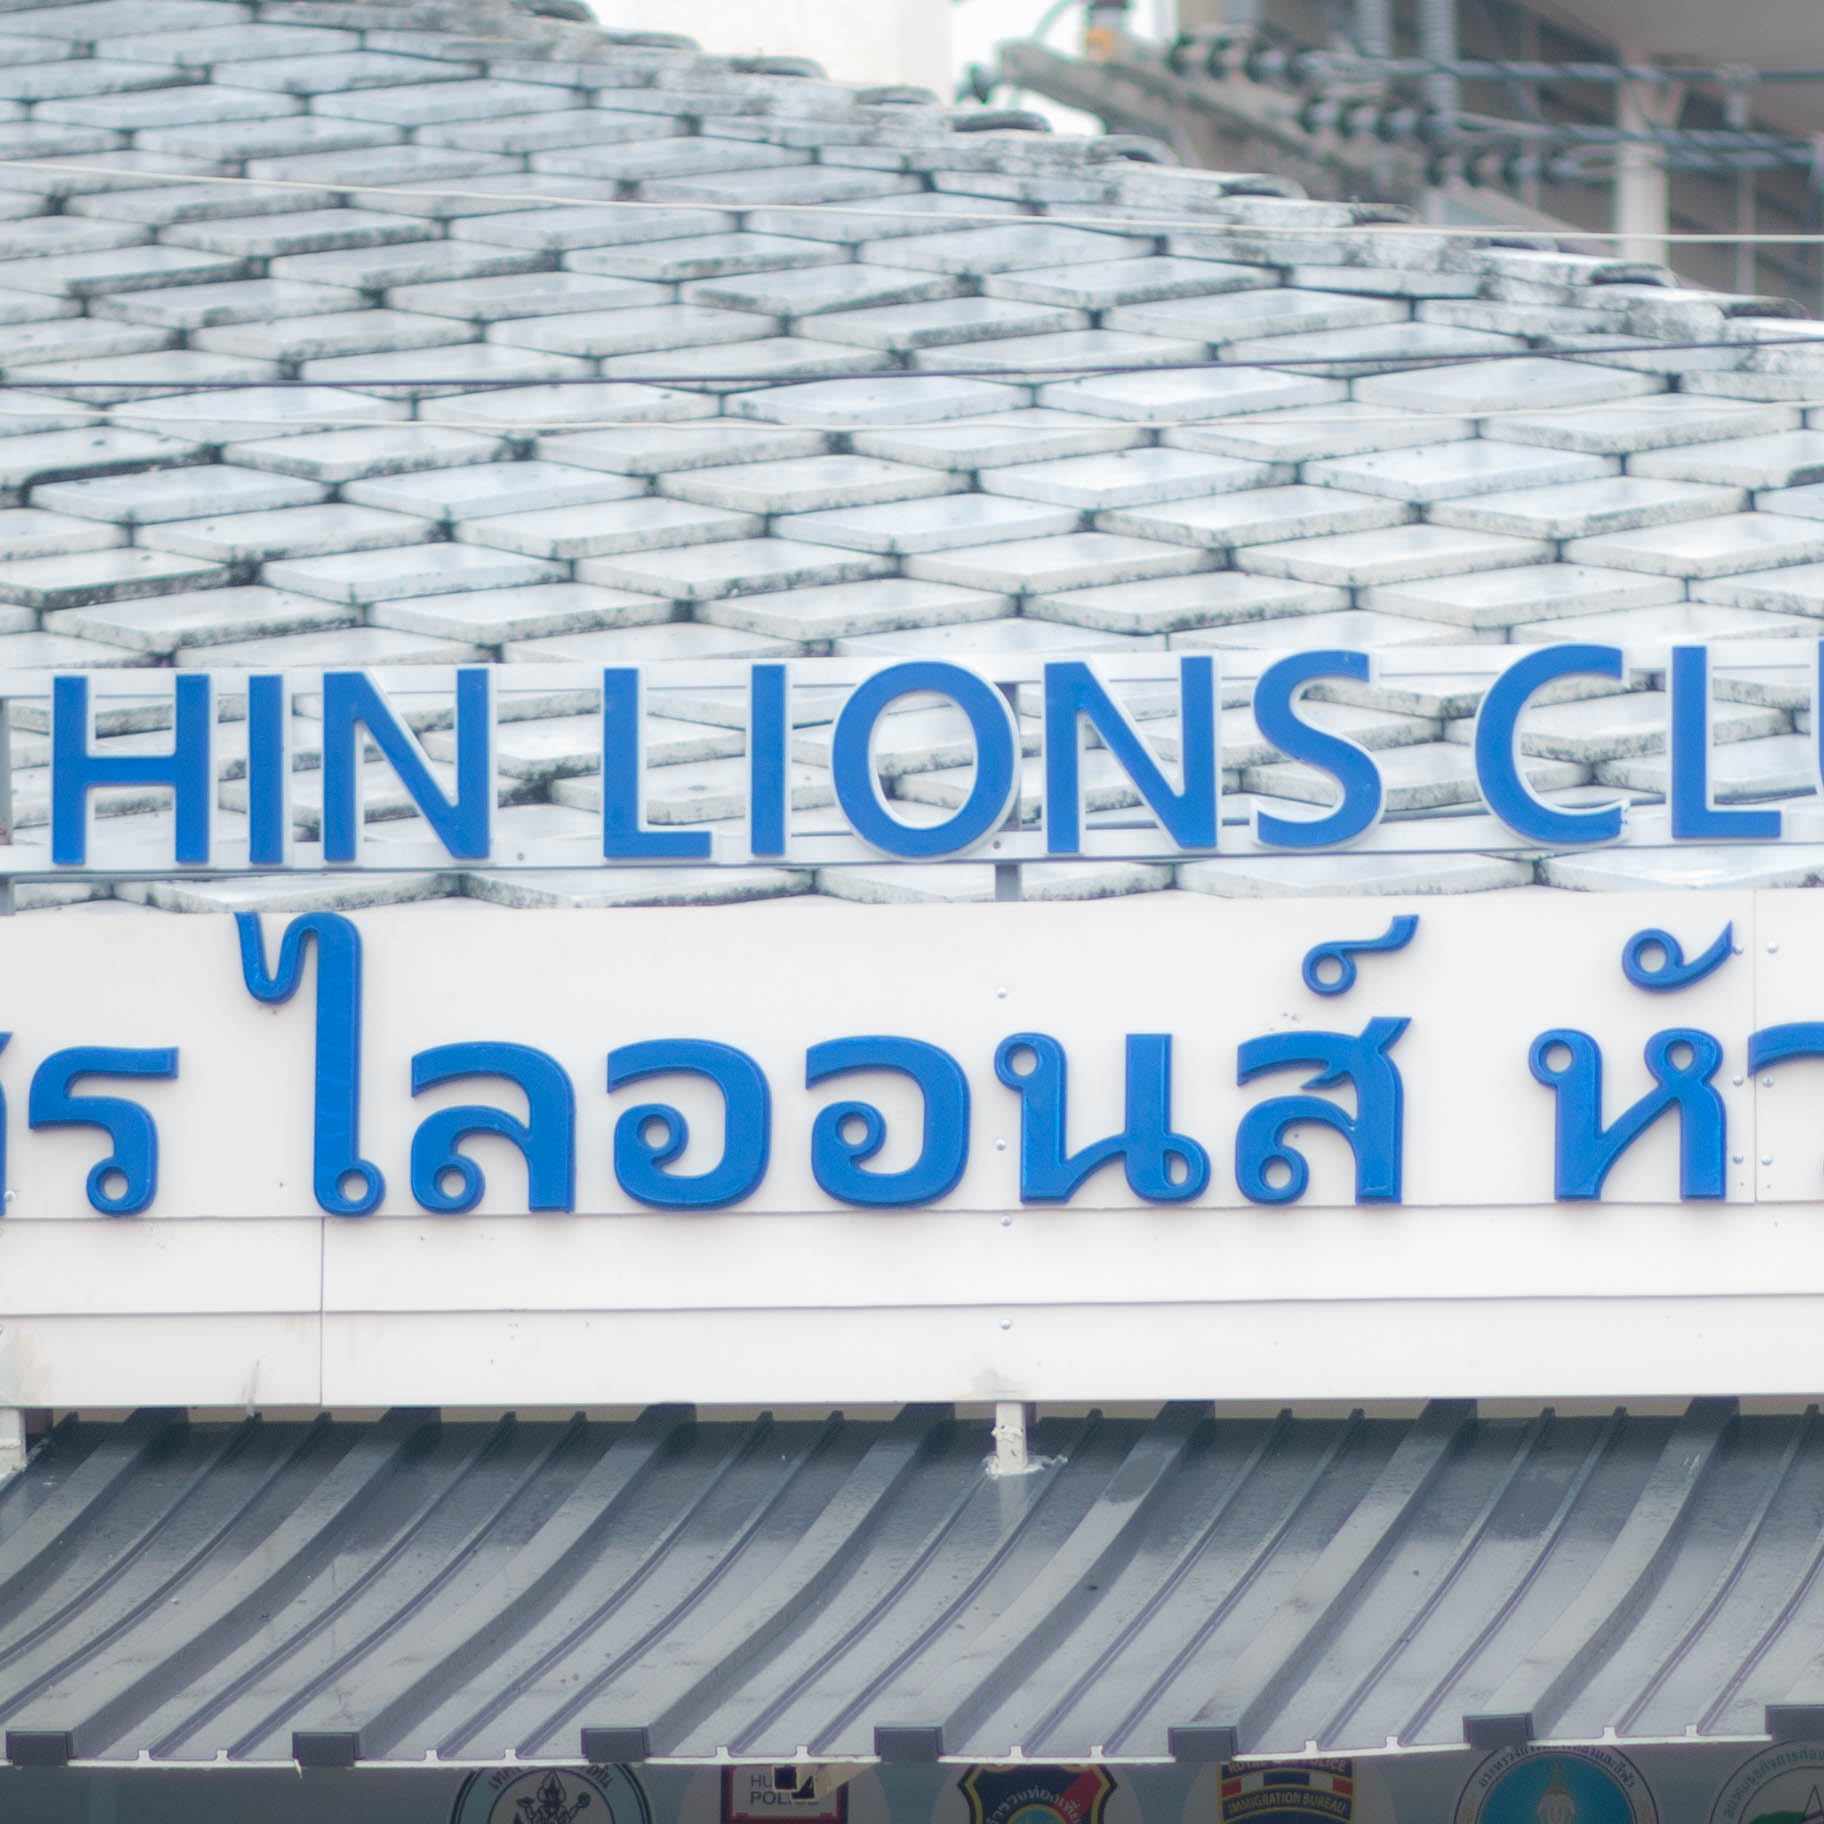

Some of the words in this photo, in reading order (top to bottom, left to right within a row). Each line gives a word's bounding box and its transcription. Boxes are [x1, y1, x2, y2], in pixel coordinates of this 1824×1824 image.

[52, 668, 490, 868] HIN
[601, 652, 1388, 861] LIONS
[1227, 1791, 1301, 1812] IMMIGRATION
[1304, 1791, 1347, 1817] BUREAU
